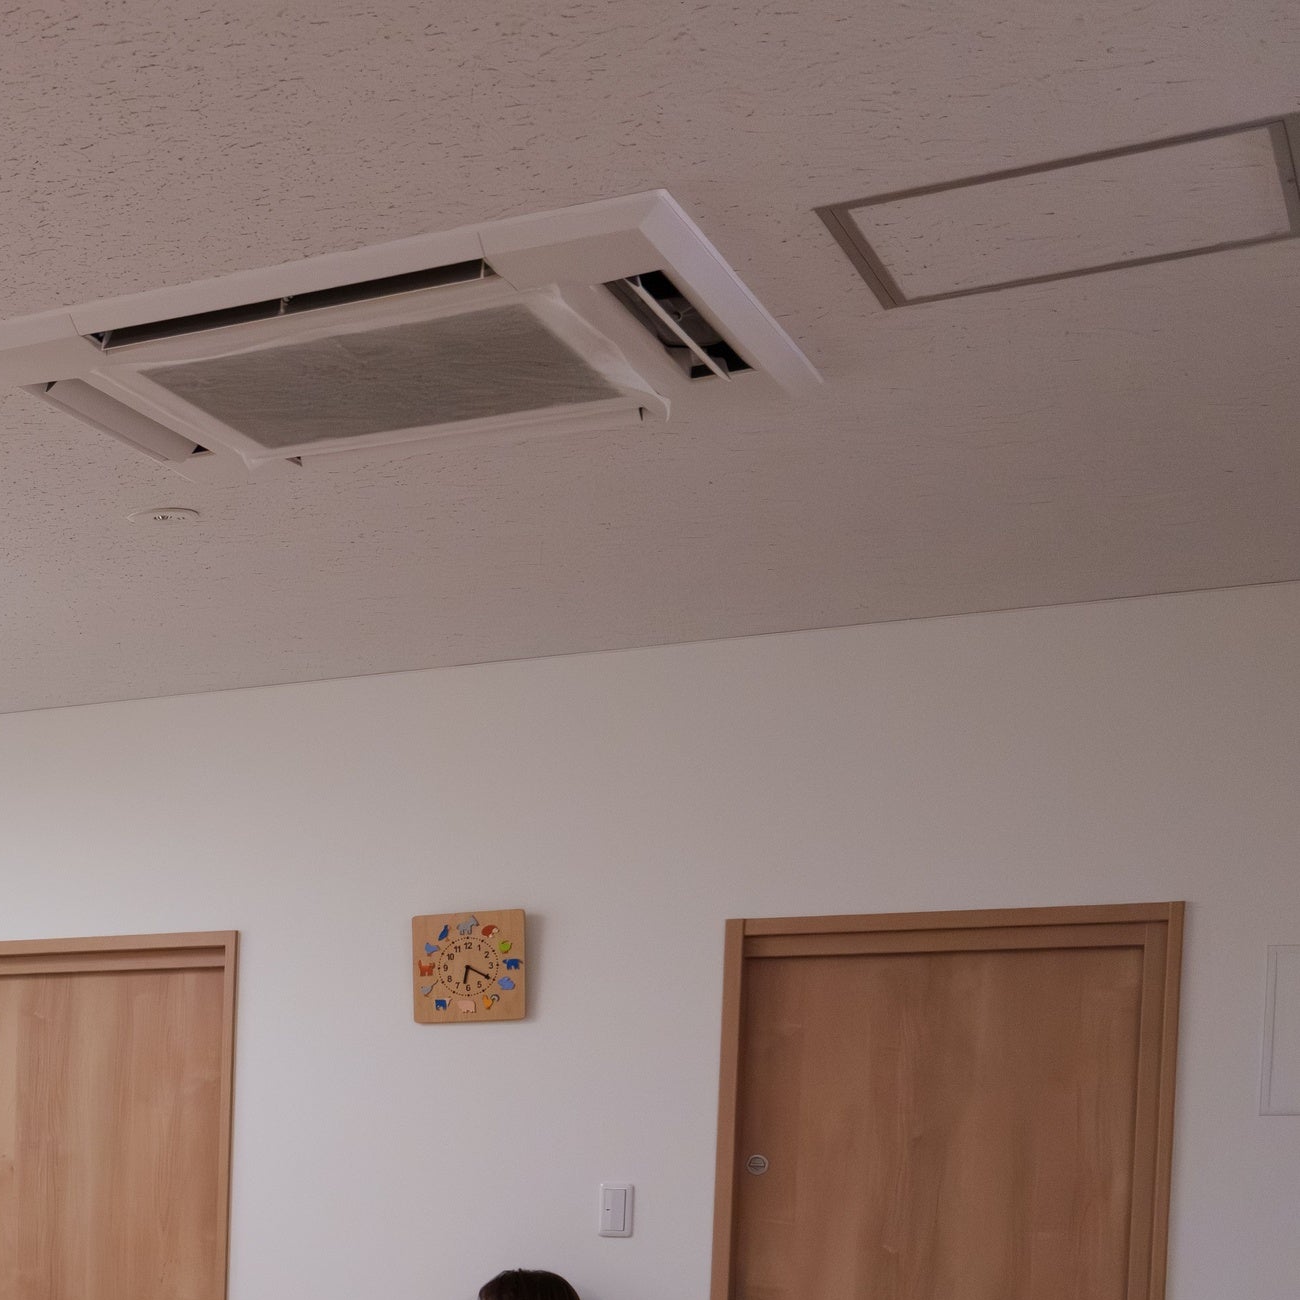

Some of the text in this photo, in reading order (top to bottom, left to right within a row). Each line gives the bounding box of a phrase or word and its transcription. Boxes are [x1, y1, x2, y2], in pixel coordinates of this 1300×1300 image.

[454, 945, 461, 953] 11
[464, 942, 472, 950] 12
[484, 951, 489, 959] 2
[443, 964, 448, 972] 9
[447, 975, 452, 983] 8
[455, 981, 460, 989] 7
[477, 980, 482, 988] 5
